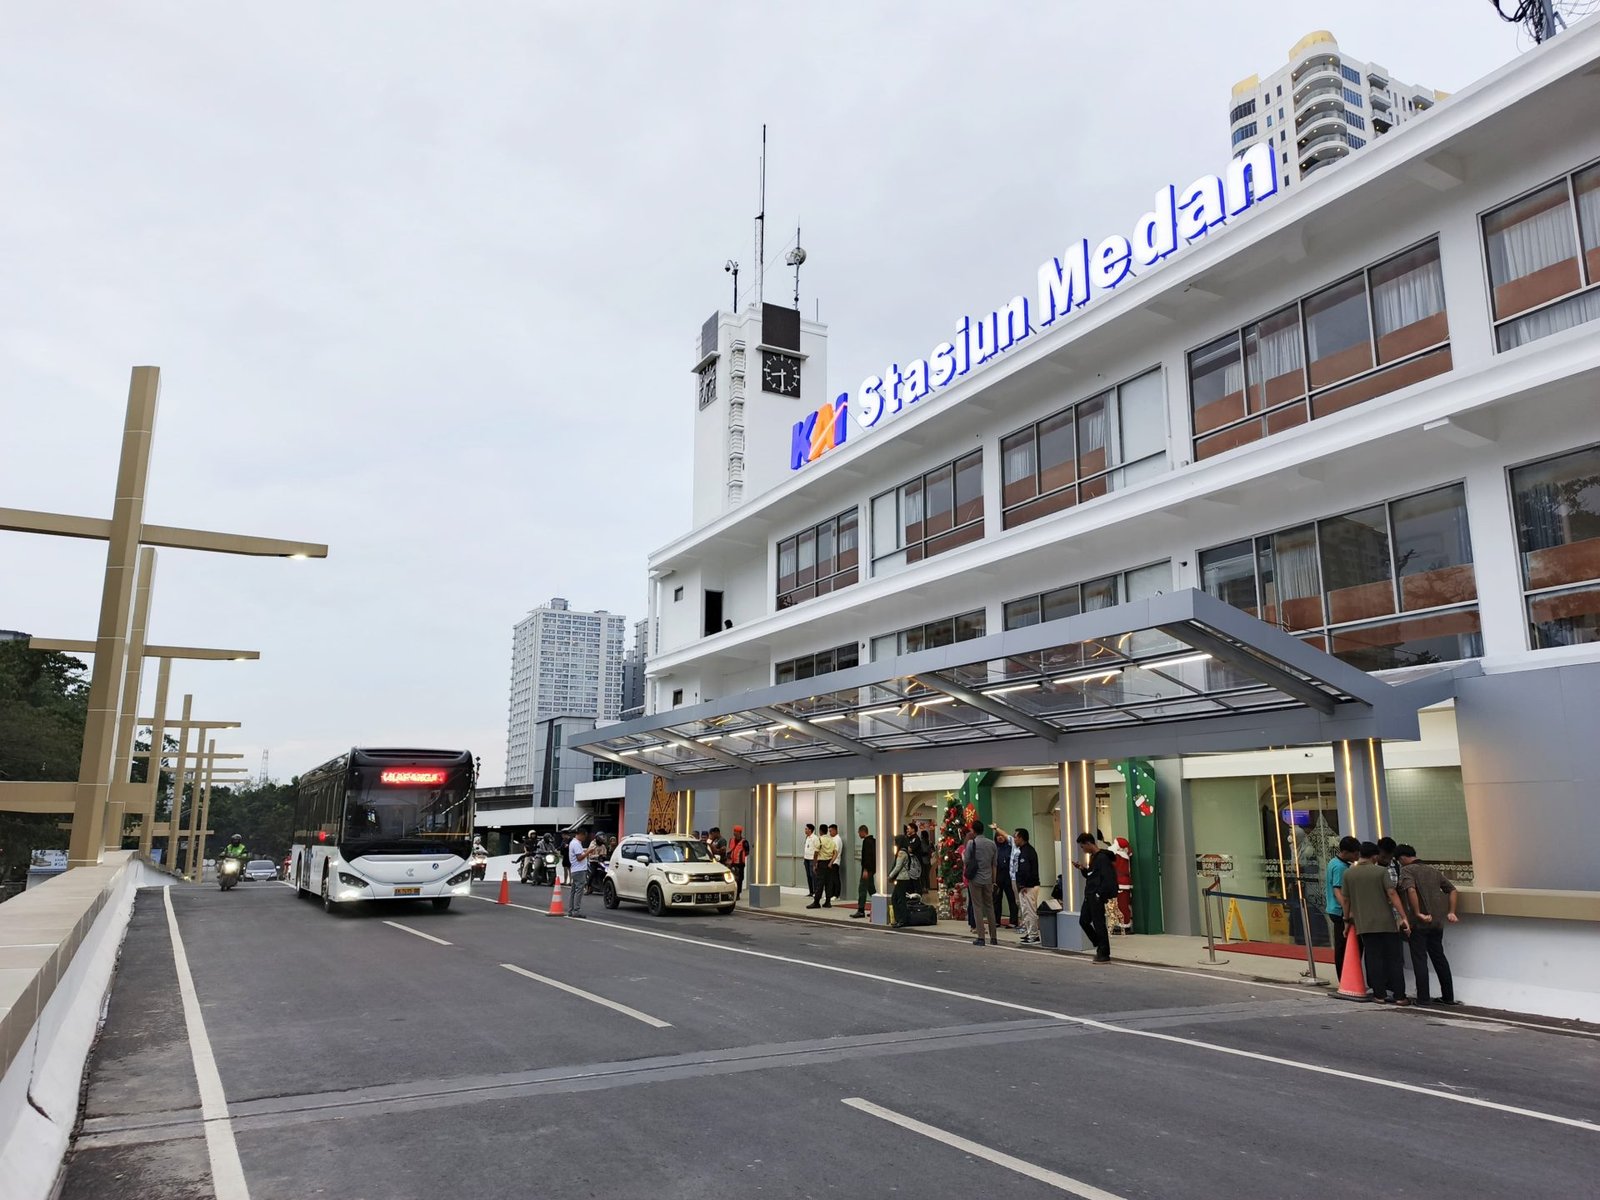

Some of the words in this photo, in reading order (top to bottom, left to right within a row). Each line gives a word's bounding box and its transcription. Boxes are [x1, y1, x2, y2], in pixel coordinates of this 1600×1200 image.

[791, 392, 848, 471] KAI
[858, 295, 1029, 427] Stasiun
[1037, 143, 1278, 327] Medan
[1457, 871, 1473, 879] KAI
